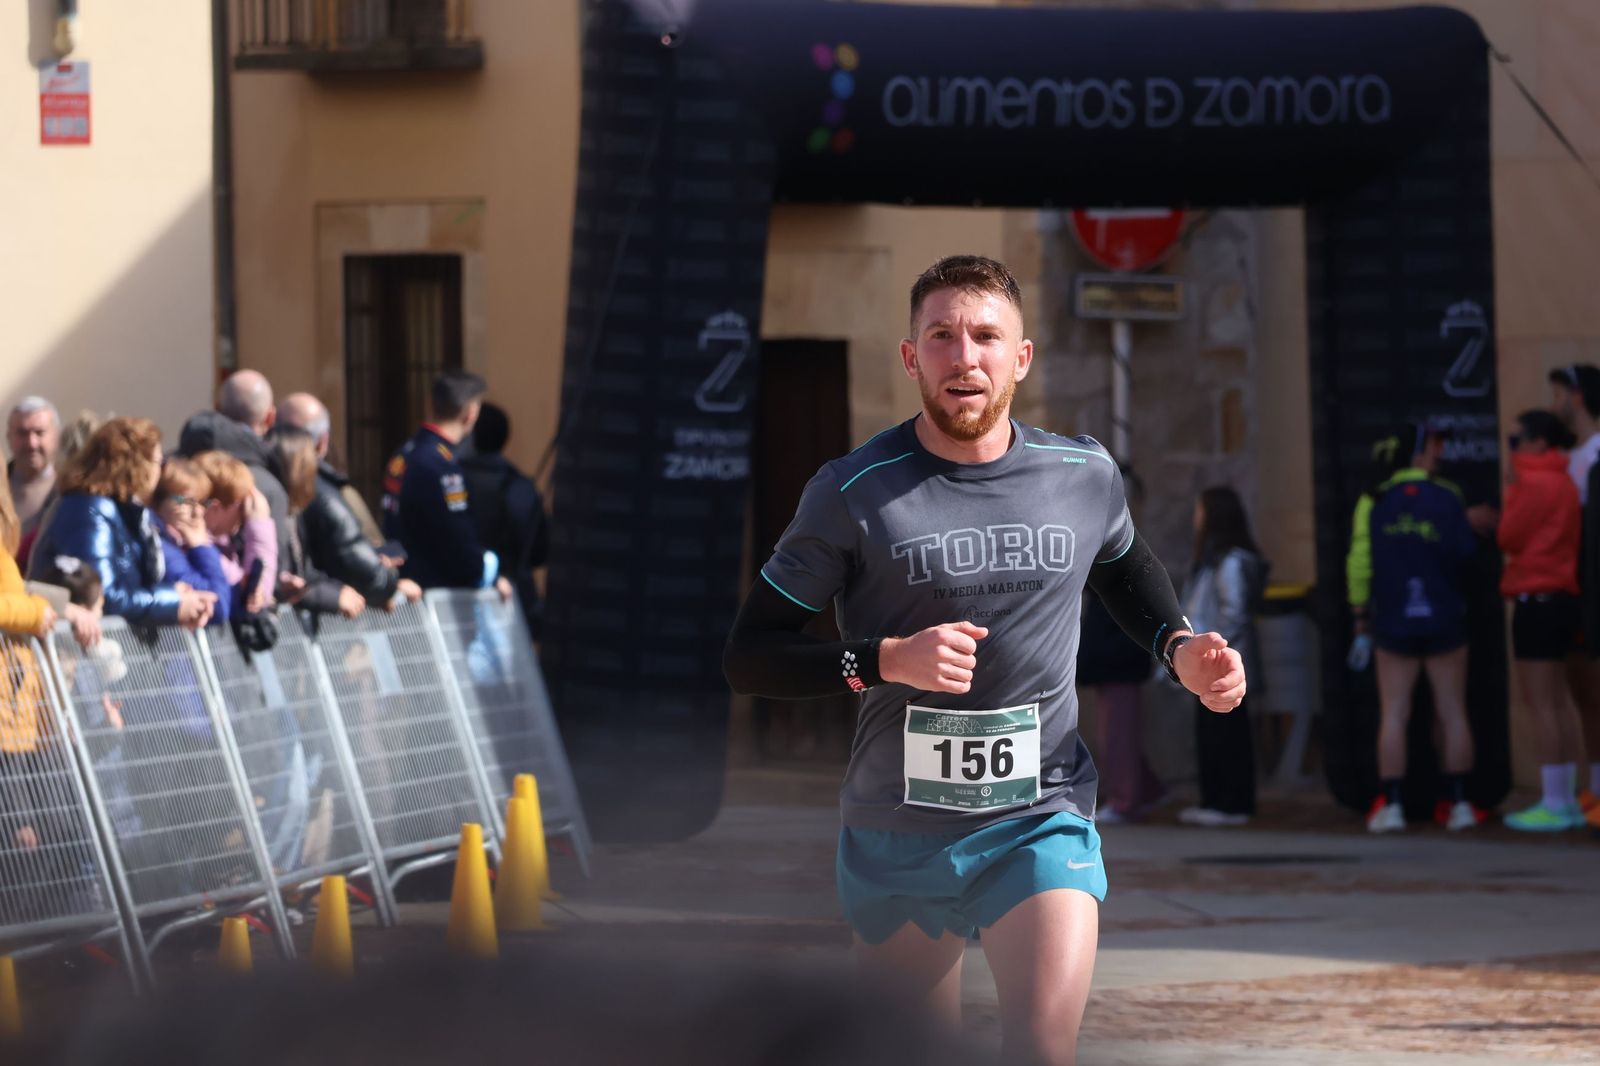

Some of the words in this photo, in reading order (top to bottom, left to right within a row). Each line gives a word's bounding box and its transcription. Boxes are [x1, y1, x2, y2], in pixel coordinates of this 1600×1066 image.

[1193, 74, 1392, 124] zamora
[890, 524, 1075, 585] TORO
[934, 588, 947, 599] IV
[948, 583, 985, 598] MEDIA
[987, 579, 1044, 595] MARATON
[974, 607, 1012, 618] acciona
[933, 738, 1014, 780] 156
